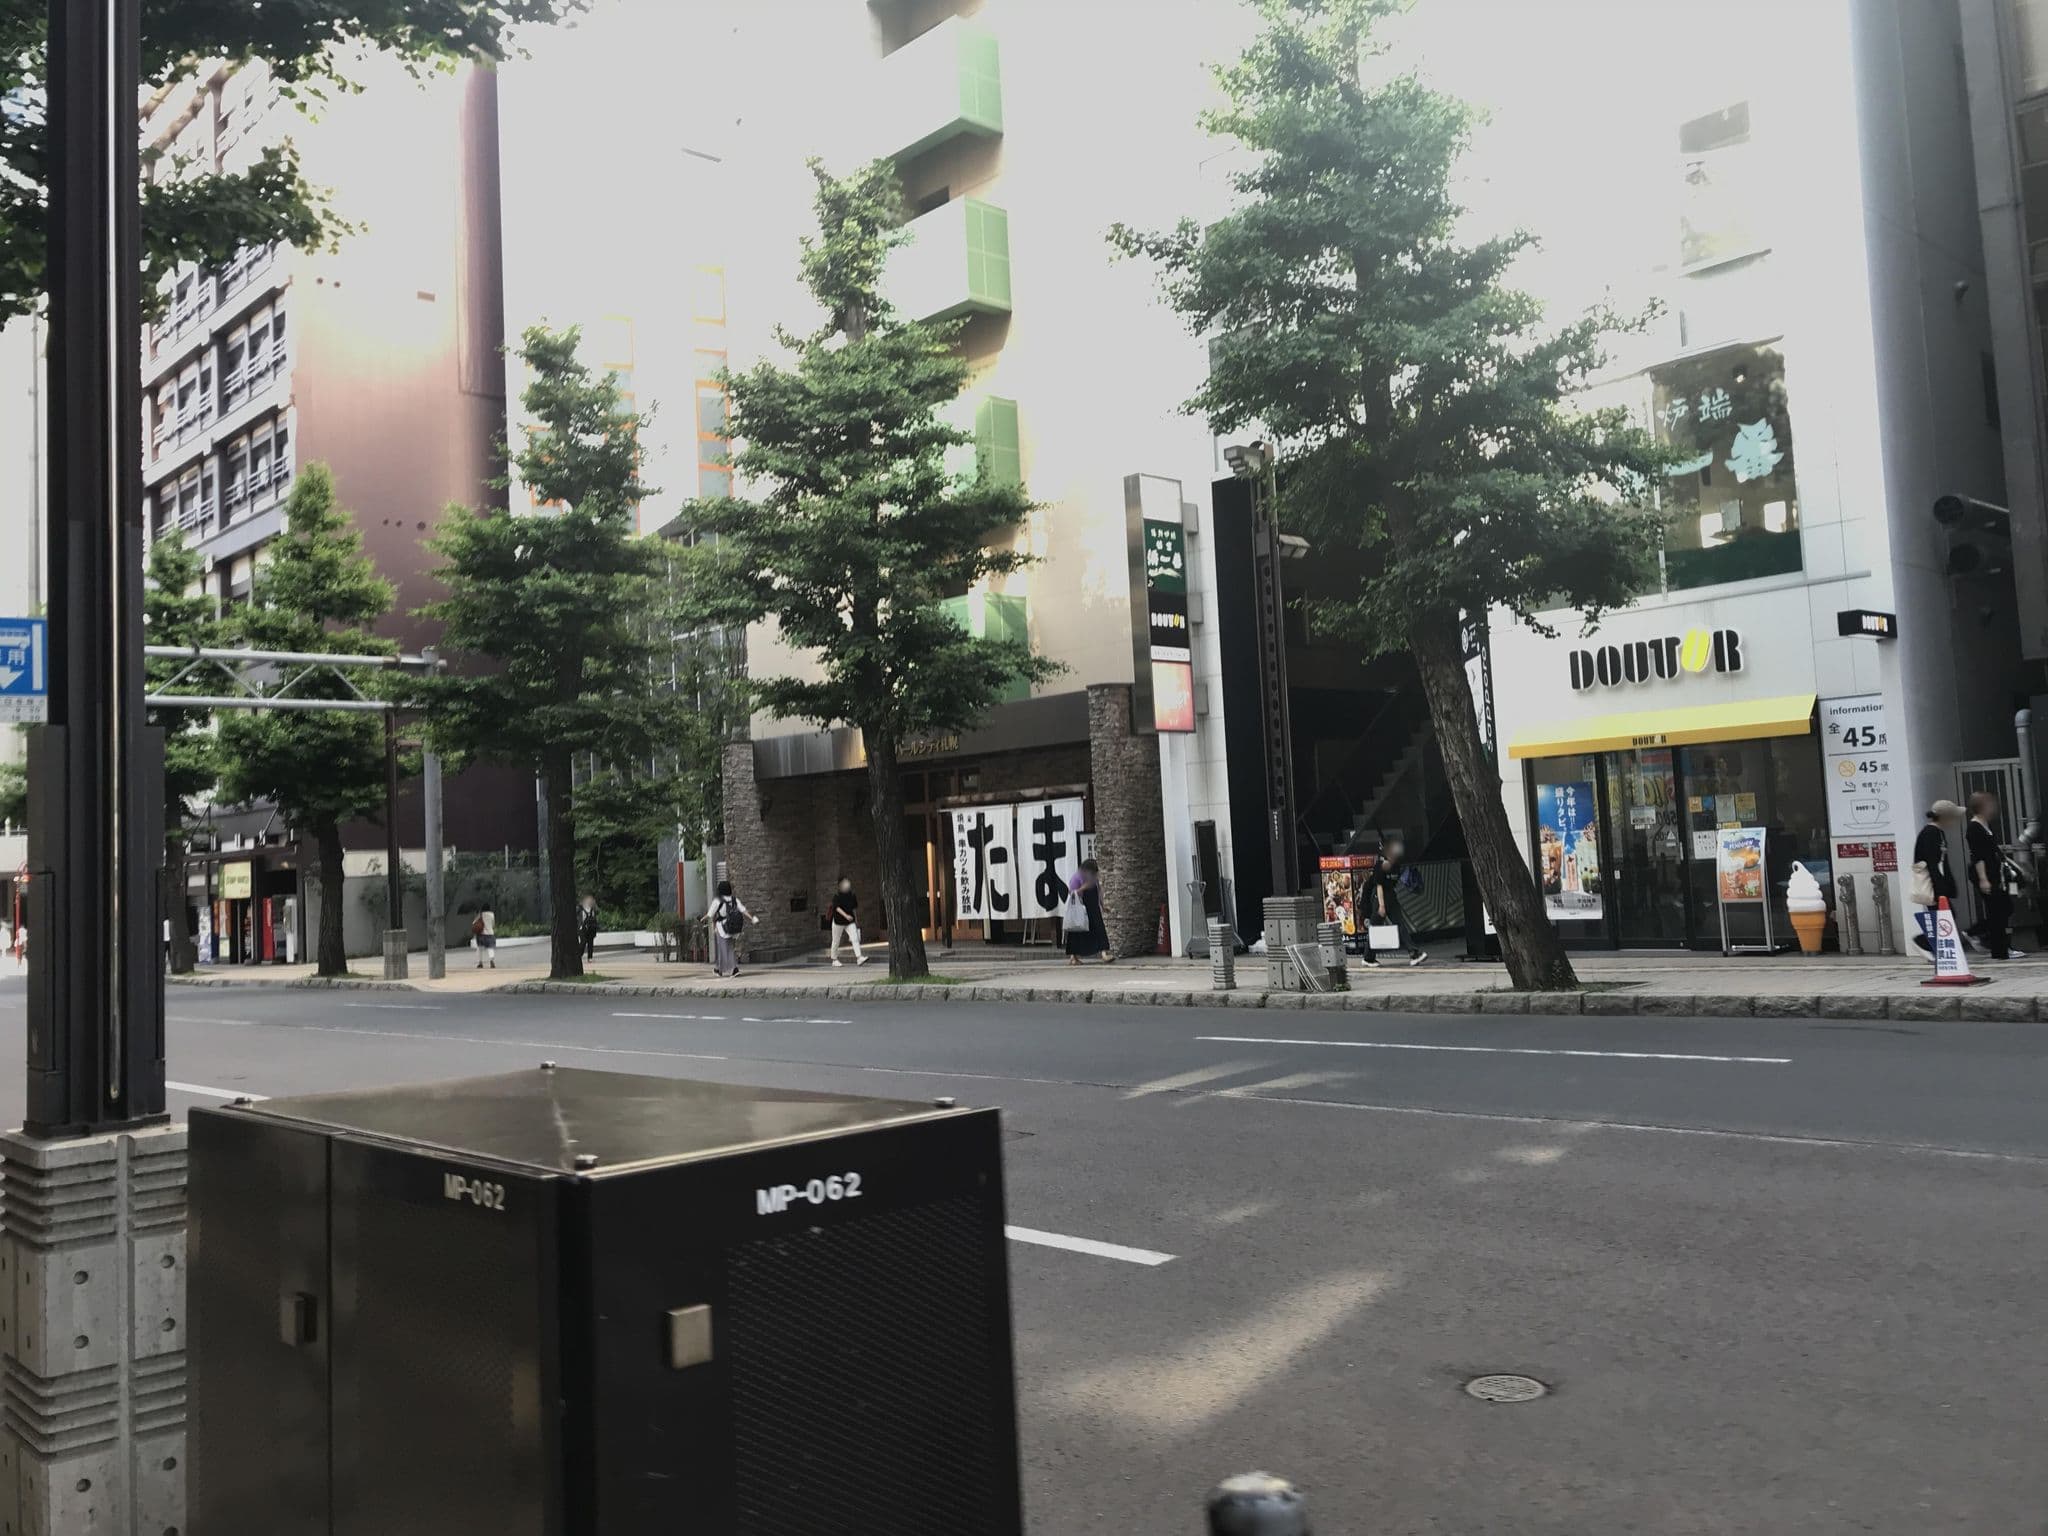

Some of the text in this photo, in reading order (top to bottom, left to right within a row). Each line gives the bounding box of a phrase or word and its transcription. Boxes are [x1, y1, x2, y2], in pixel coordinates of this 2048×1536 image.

[1151, 612, 1185, 629] DOUTOR
[1569, 629, 1742, 690] DOUTOR
[444, 1172, 505, 1210] MP-062
[756, 1171, 862, 1215] MP-062
